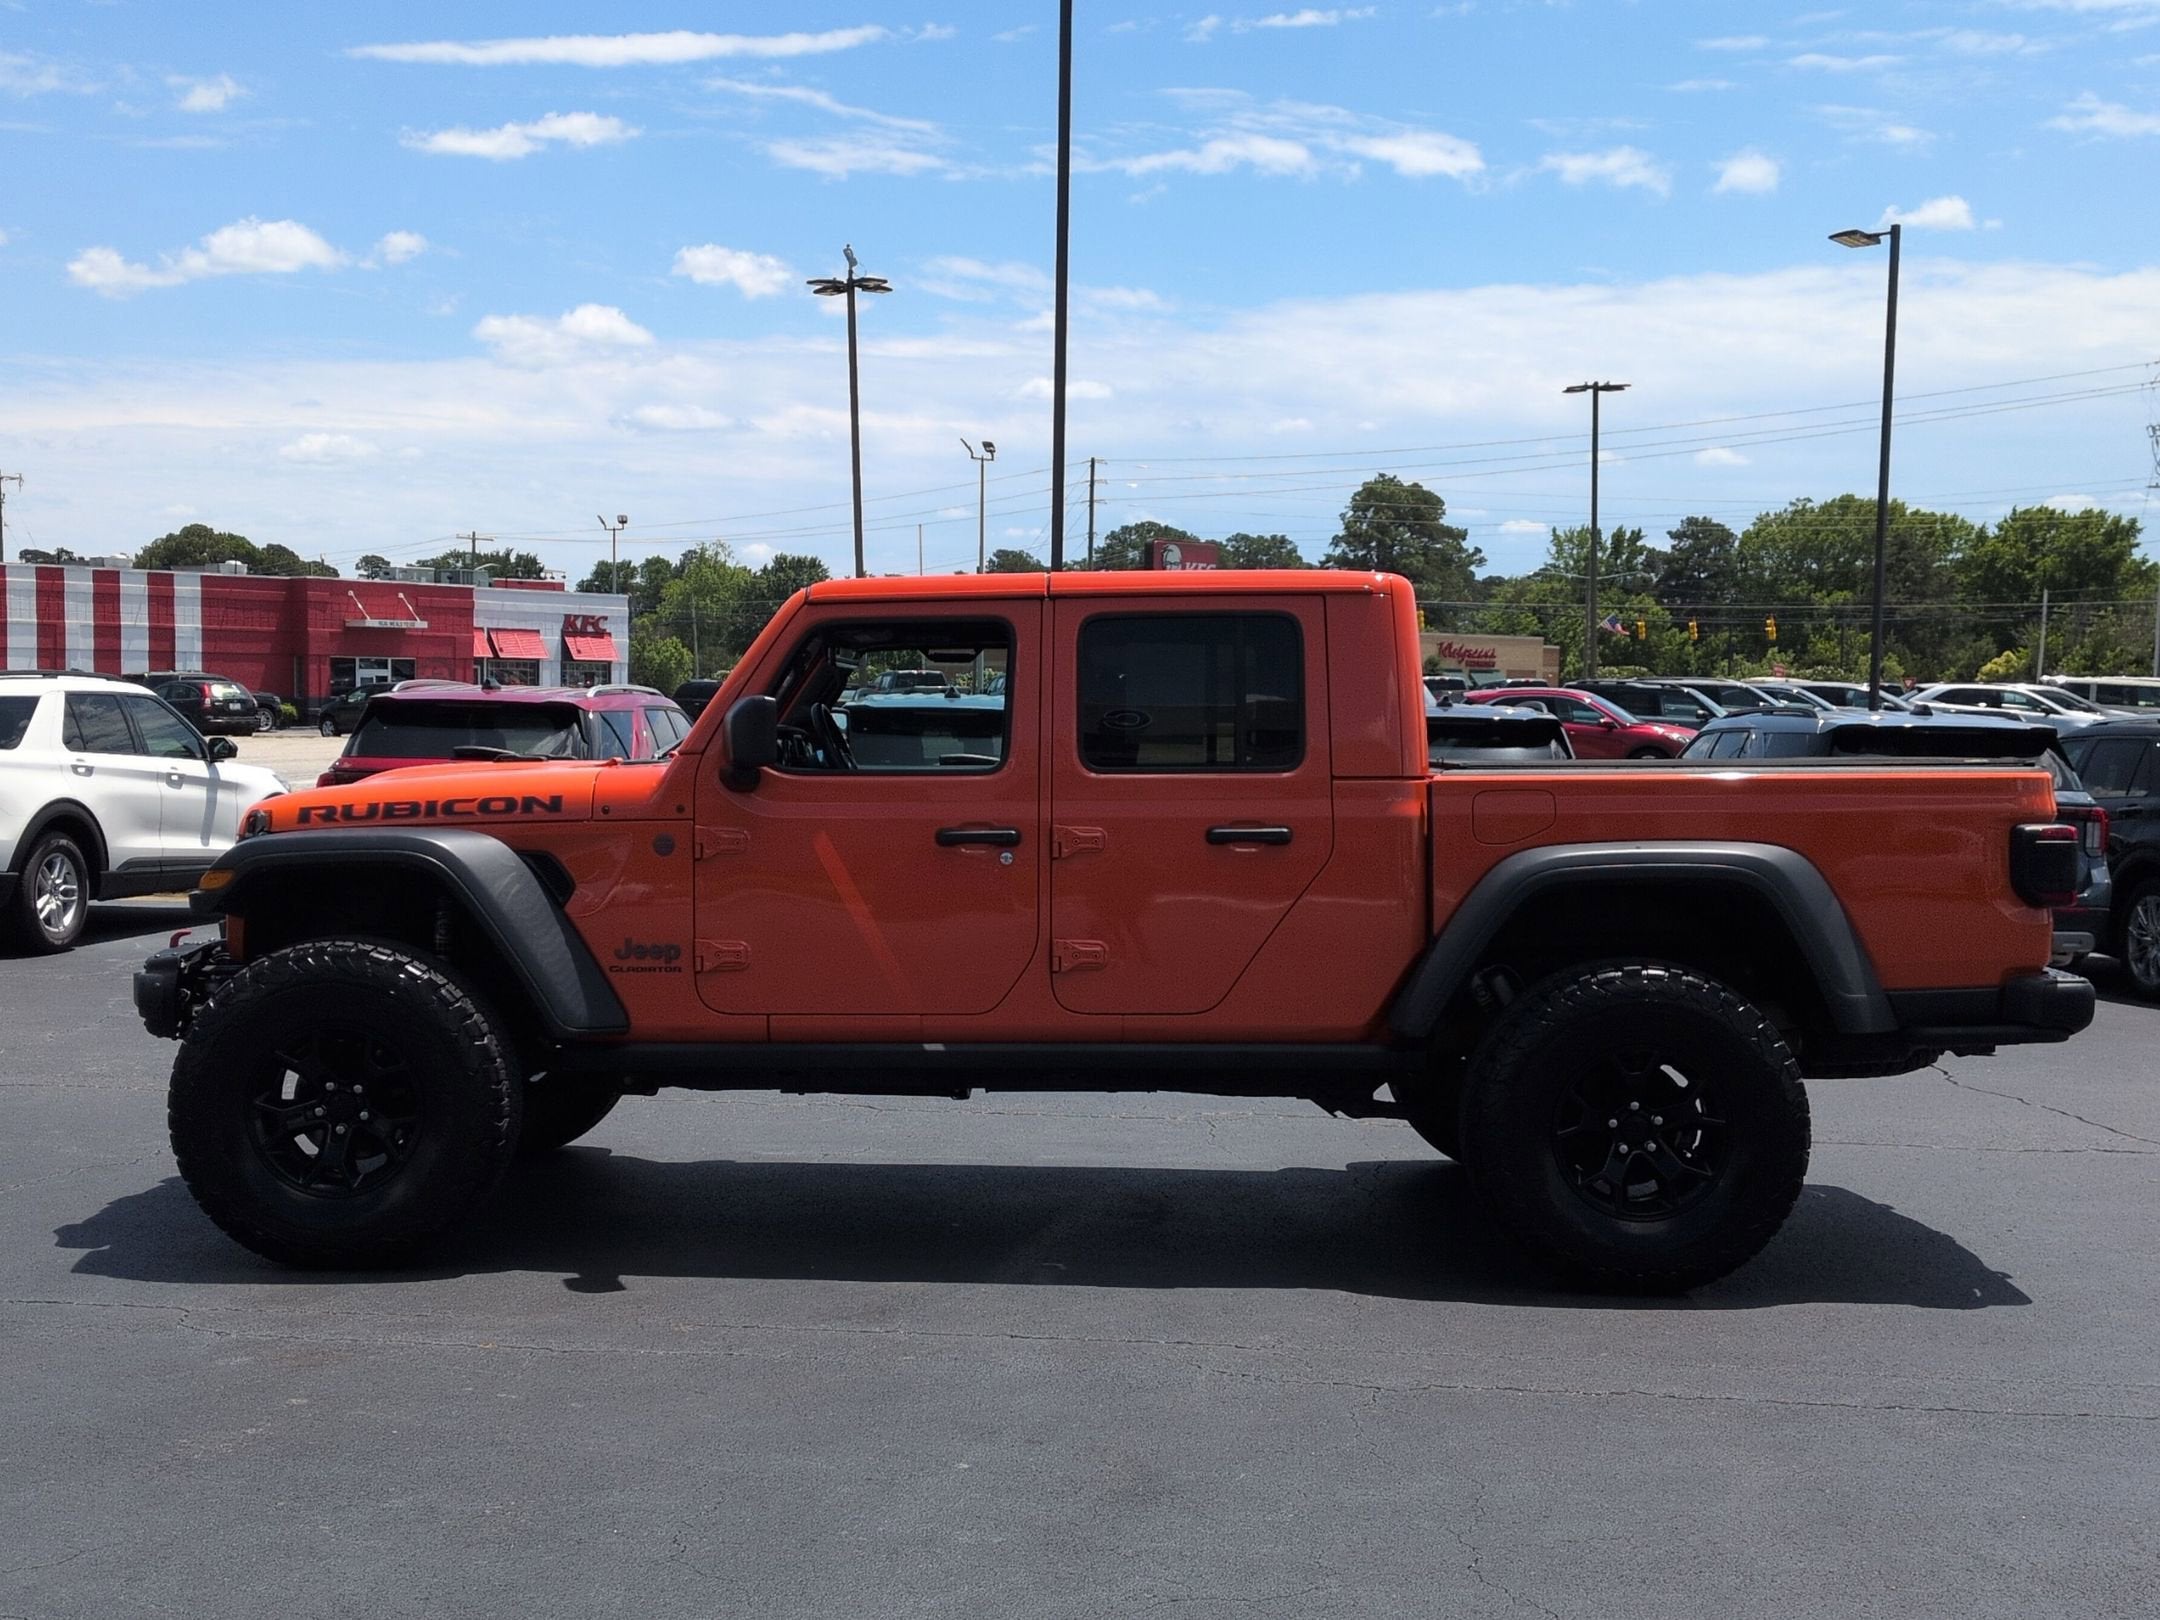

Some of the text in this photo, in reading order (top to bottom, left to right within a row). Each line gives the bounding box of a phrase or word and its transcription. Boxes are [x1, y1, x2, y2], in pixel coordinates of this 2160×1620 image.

[562, 614, 608, 633] KFC
[297, 795, 563, 824] RUBICON
[614, 937, 681, 964] Jeep
[609, 965, 682, 973] GLADIATOR
